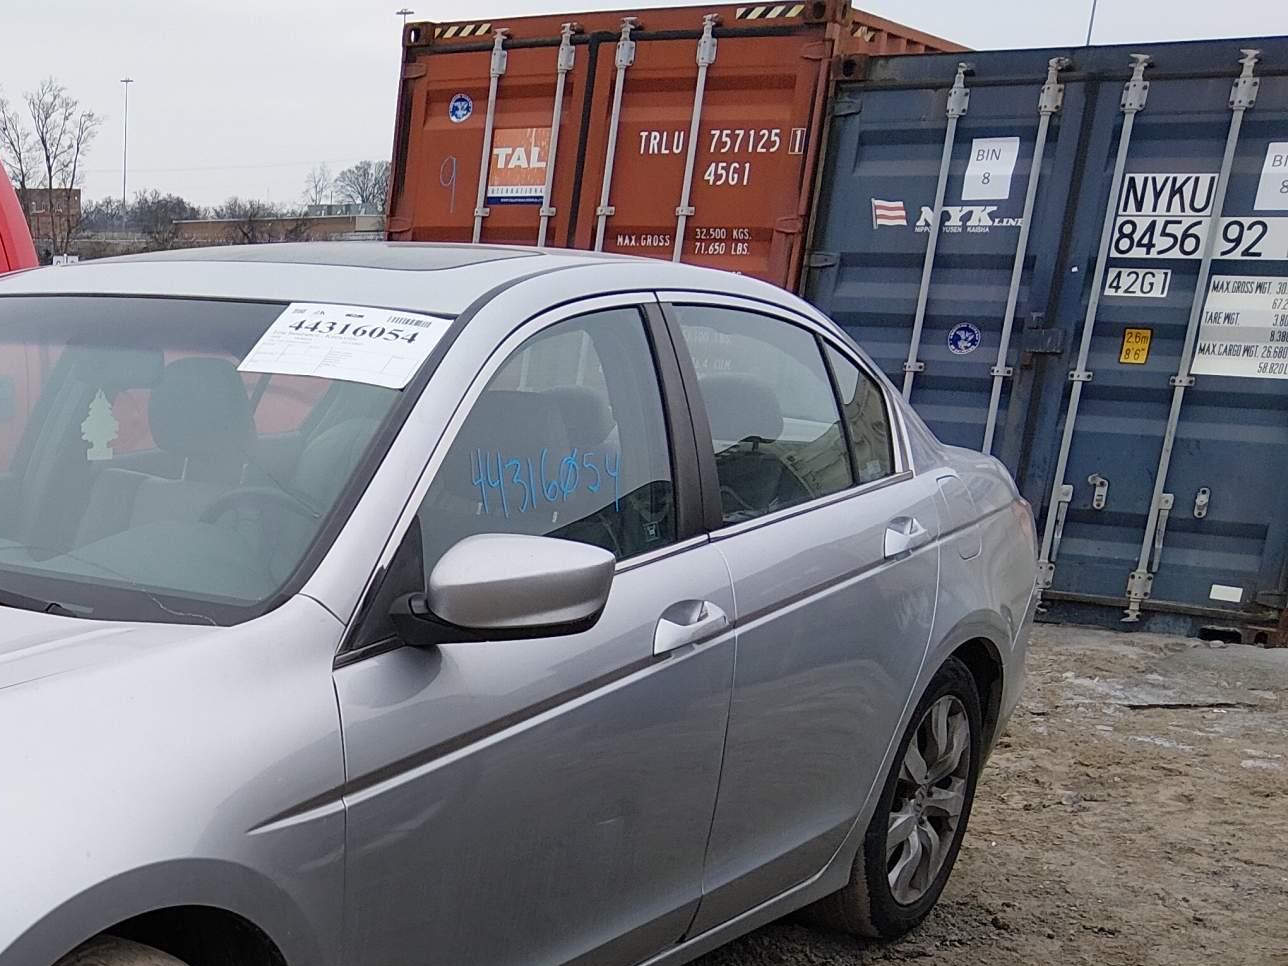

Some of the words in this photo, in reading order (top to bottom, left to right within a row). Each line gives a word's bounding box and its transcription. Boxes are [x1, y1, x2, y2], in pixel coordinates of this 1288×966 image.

[639, 130, 684, 154] TRLU
[709, 129, 780, 153] 757125
[493, 147, 546, 169] TAL
[975, 148, 1001, 161] BIN
[704, 162, 751, 186] 45G1
[981, 172, 991, 185] 8
[1122, 175, 1216, 213] NYKU
[915, 206, 998, 226] NYK
[1108, 270, 1169, 295] 42G1
[1275, 281, 1288, 295] 30.
[1272, 298, 1288, 311] 67.2
[1204, 311, 1223, 325] TARE
[289, 319, 420, 344] 44316054
[470, 448, 621, 518] 44316054
